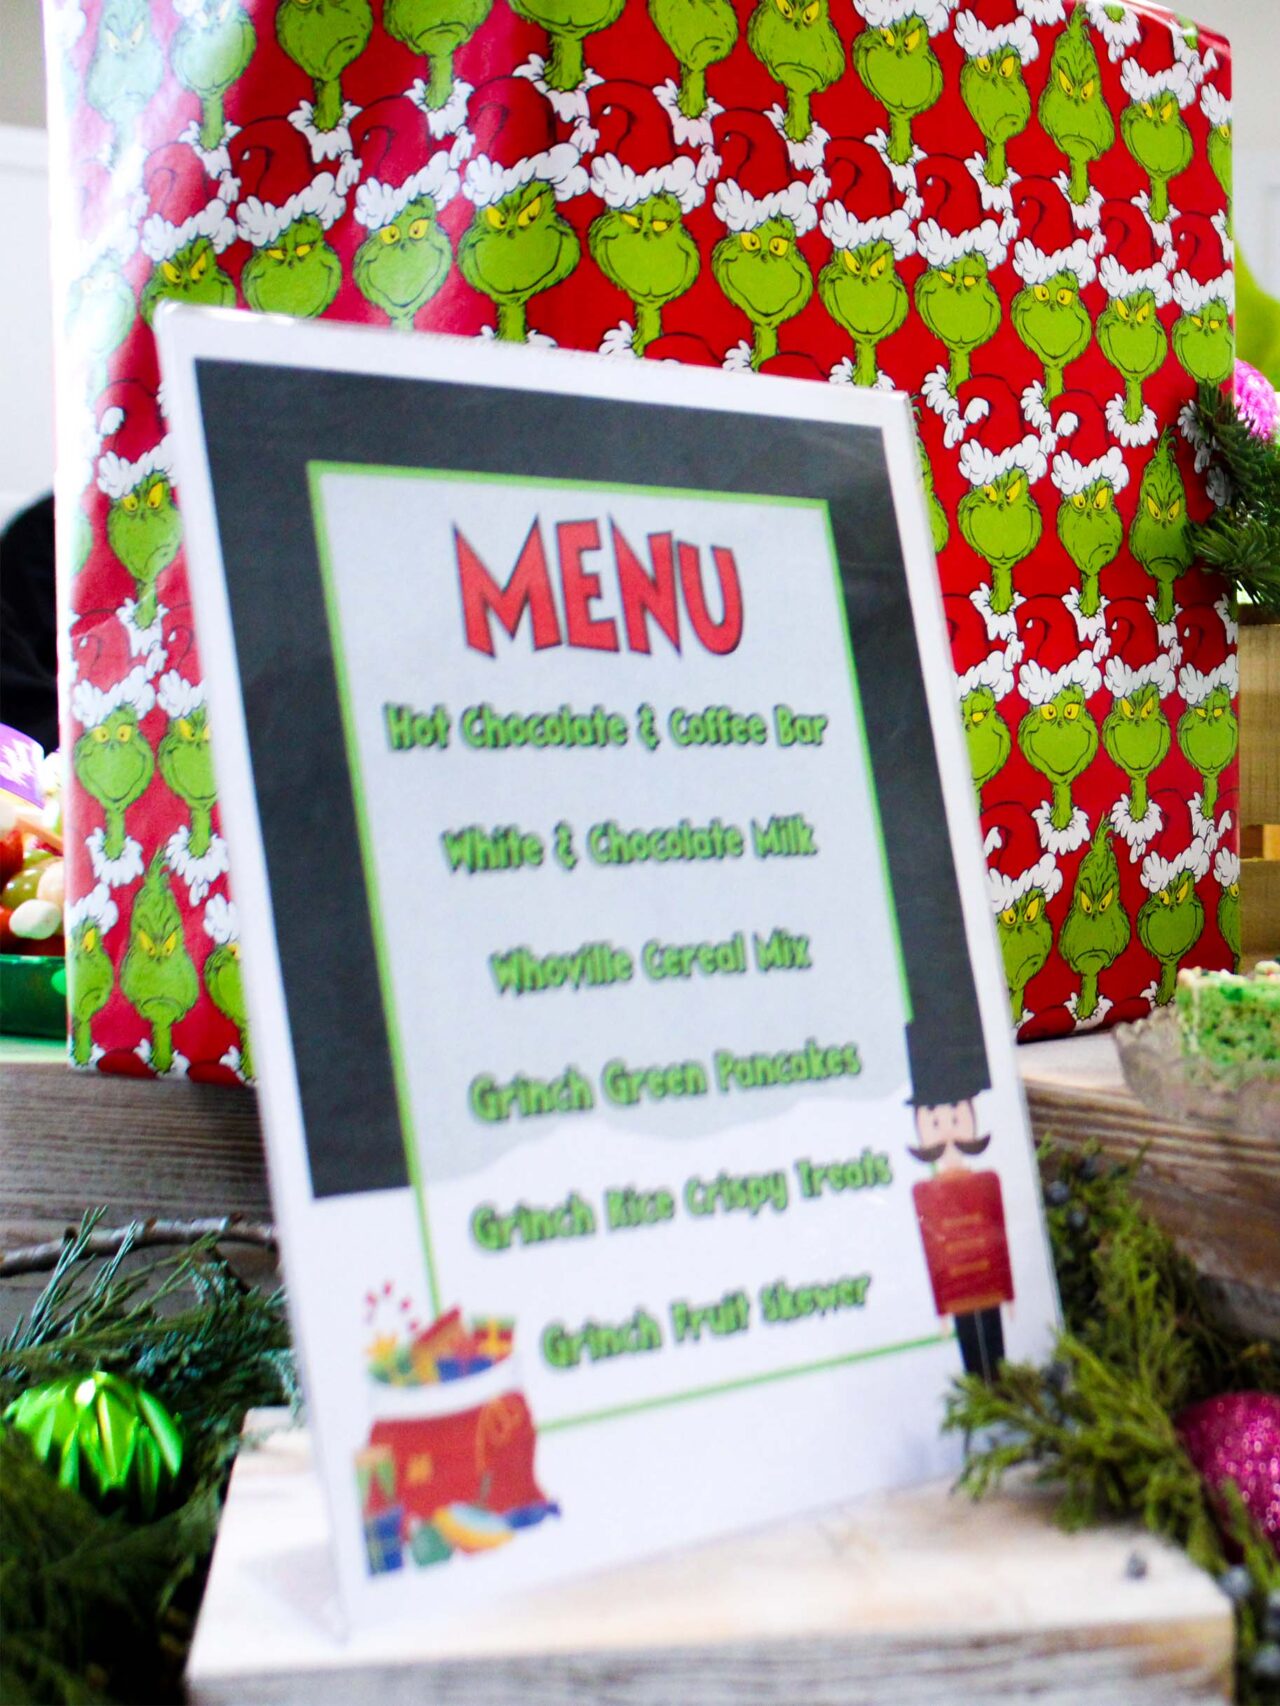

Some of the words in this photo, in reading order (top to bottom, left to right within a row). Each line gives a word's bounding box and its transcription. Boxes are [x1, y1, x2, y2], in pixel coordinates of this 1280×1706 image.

[453, 513, 744, 659] MENU
[384, 702, 451, 751] Hot
[462, 702, 628, 750] Chocolate
[638, 703, 660, 752] &
[669, 705, 768, 747] Coffee
[773, 704, 829, 748] Bar
[443, 824, 546, 874] White
[554, 820, 578, 871] &
[587, 821, 744, 865] Chocolate
[751, 813, 818, 857] Milk
[491, 941, 633, 996] Whoville
[641, 932, 747, 981] Cereal
[753, 927, 812, 970] Mix
[469, 1065, 594, 1124] Grinch
[602, 1056, 708, 1105] Green
[713, 1037, 862, 1093] Pancakes
[470, 1194, 596, 1252] Grinch
[605, 1186, 676, 1232] Rice
[684, 1170, 790, 1217] Crispy
[795, 1148, 893, 1200] Treats
[541, 1309, 663, 1369] Grinch
[671, 1289, 751, 1344] Fruit
[759, 1273, 872, 1325] Skewer
